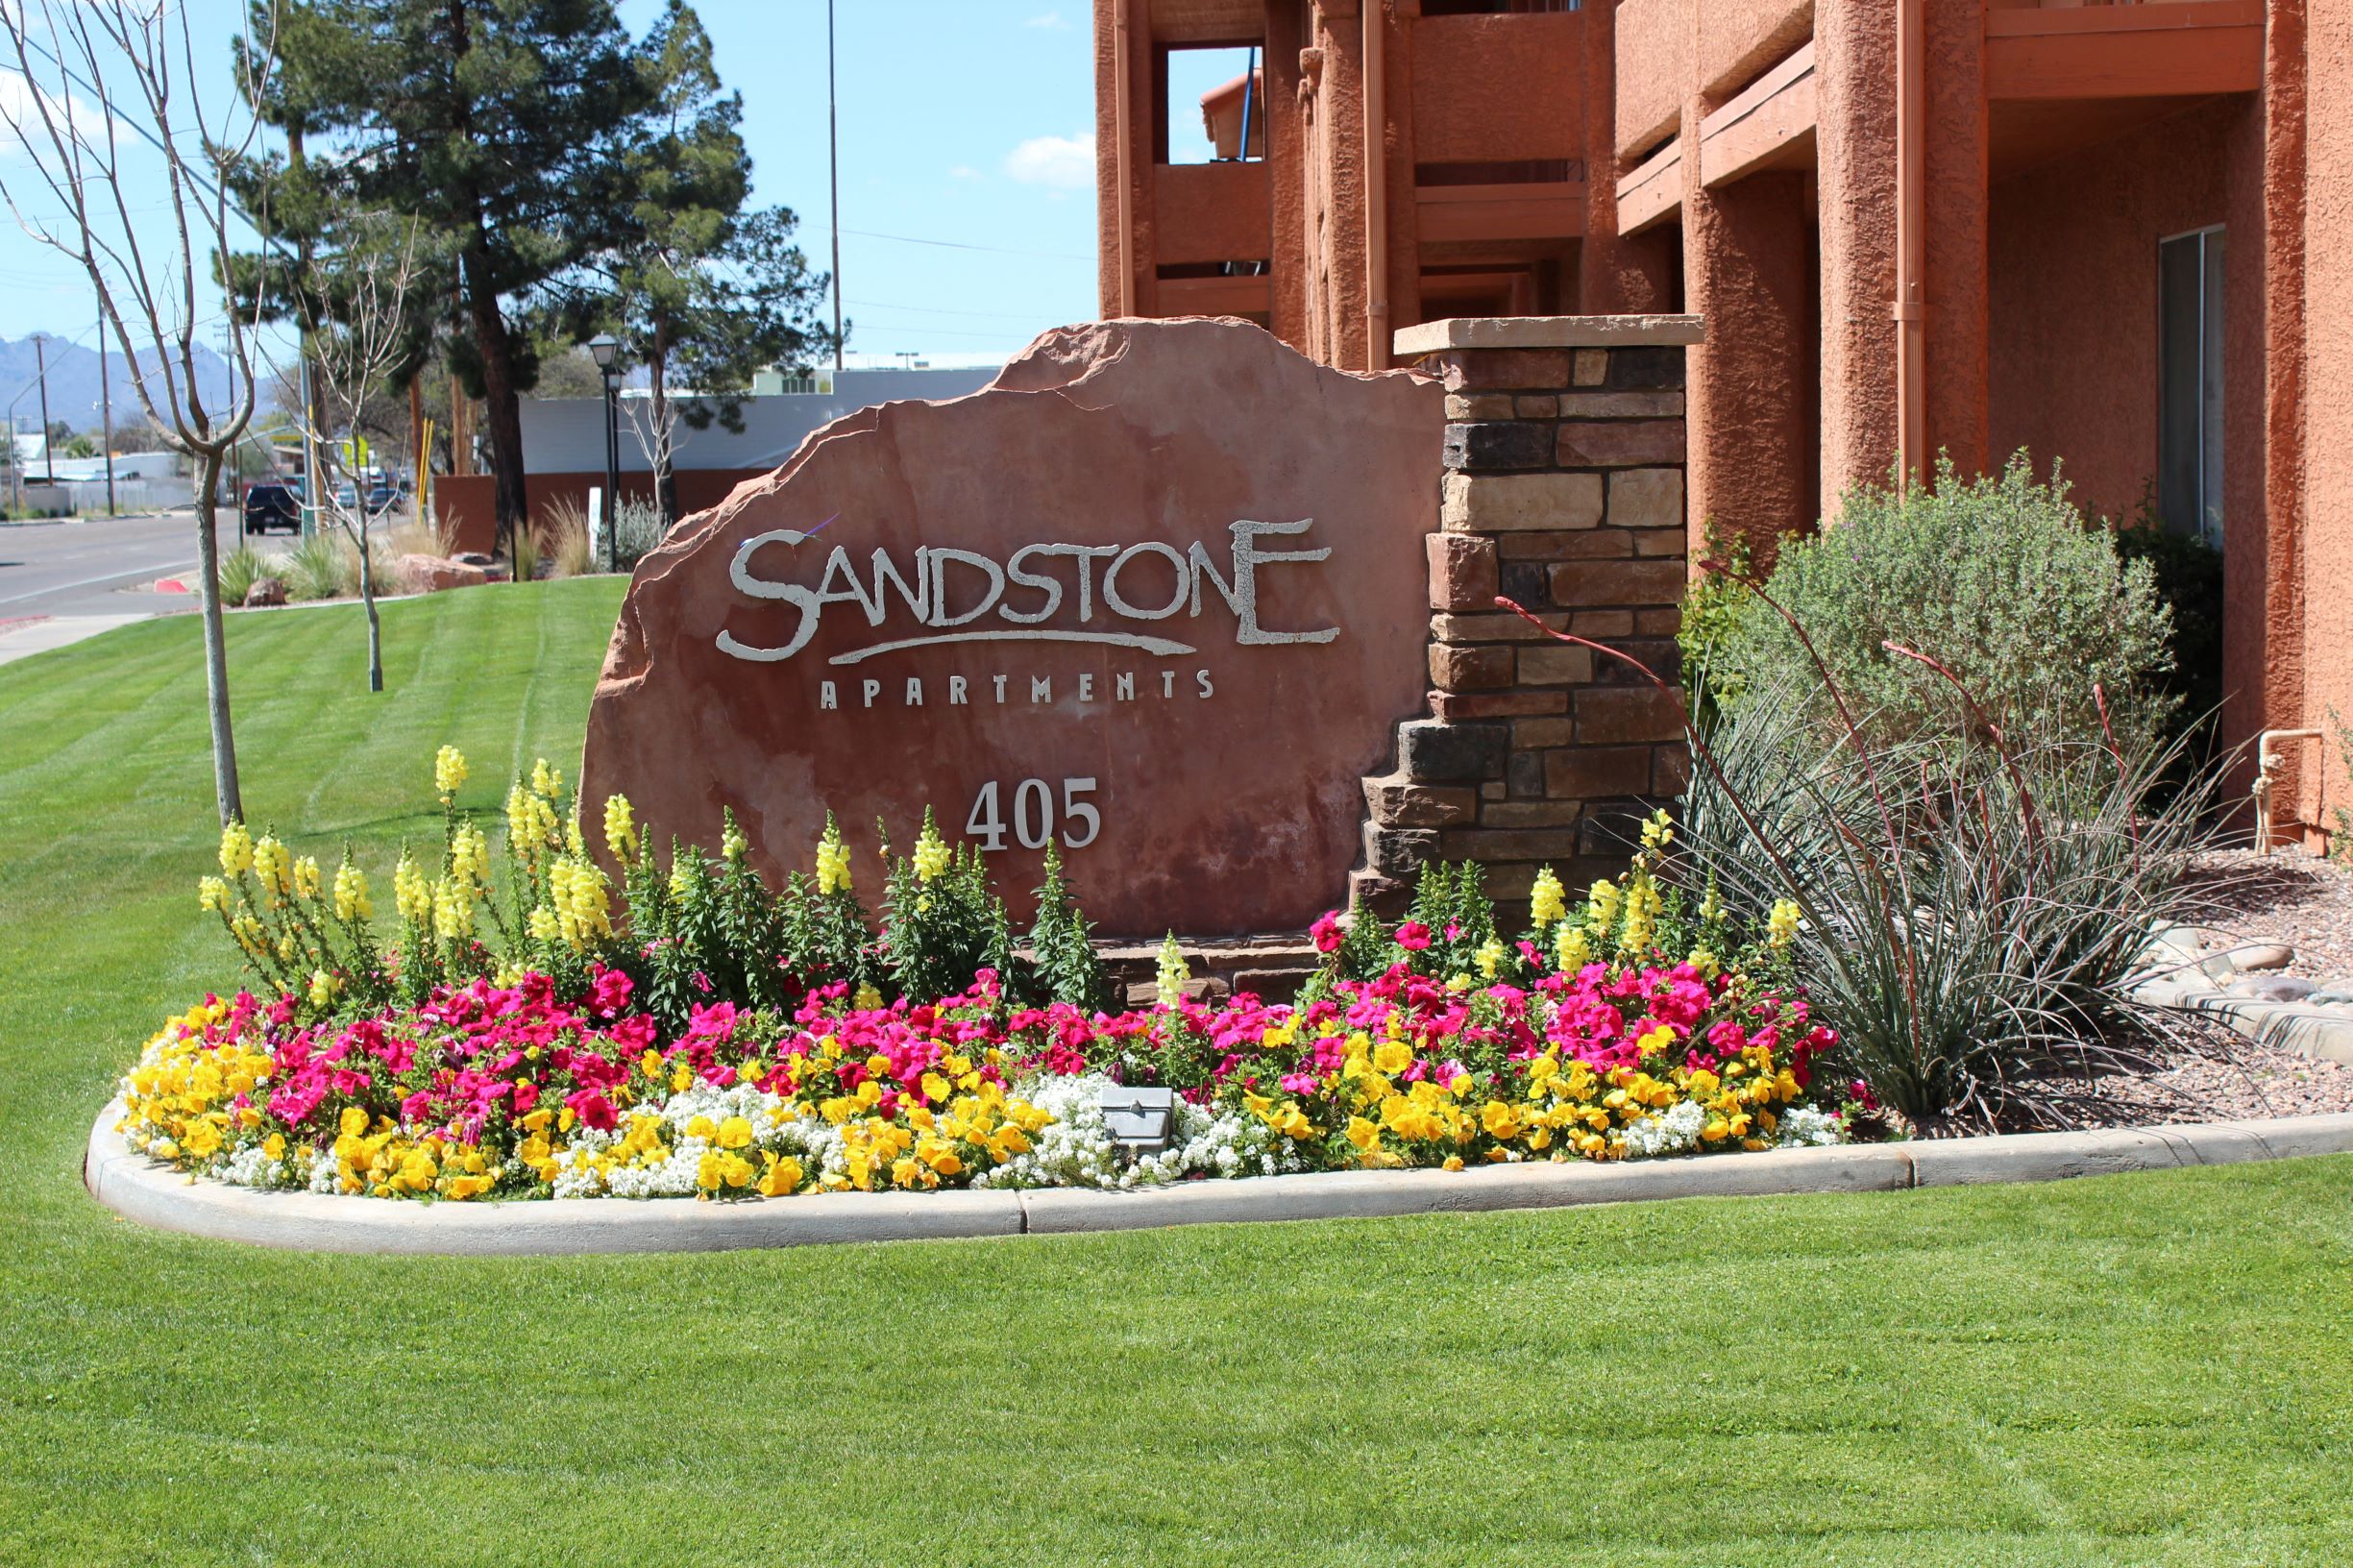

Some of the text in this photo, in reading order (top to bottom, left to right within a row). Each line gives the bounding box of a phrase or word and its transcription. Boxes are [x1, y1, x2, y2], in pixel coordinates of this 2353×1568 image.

[715, 518, 1340, 662] SANDSTONE
[821, 669, 1214, 710] APARTMENTS
[966, 777, 1101, 851] 405
